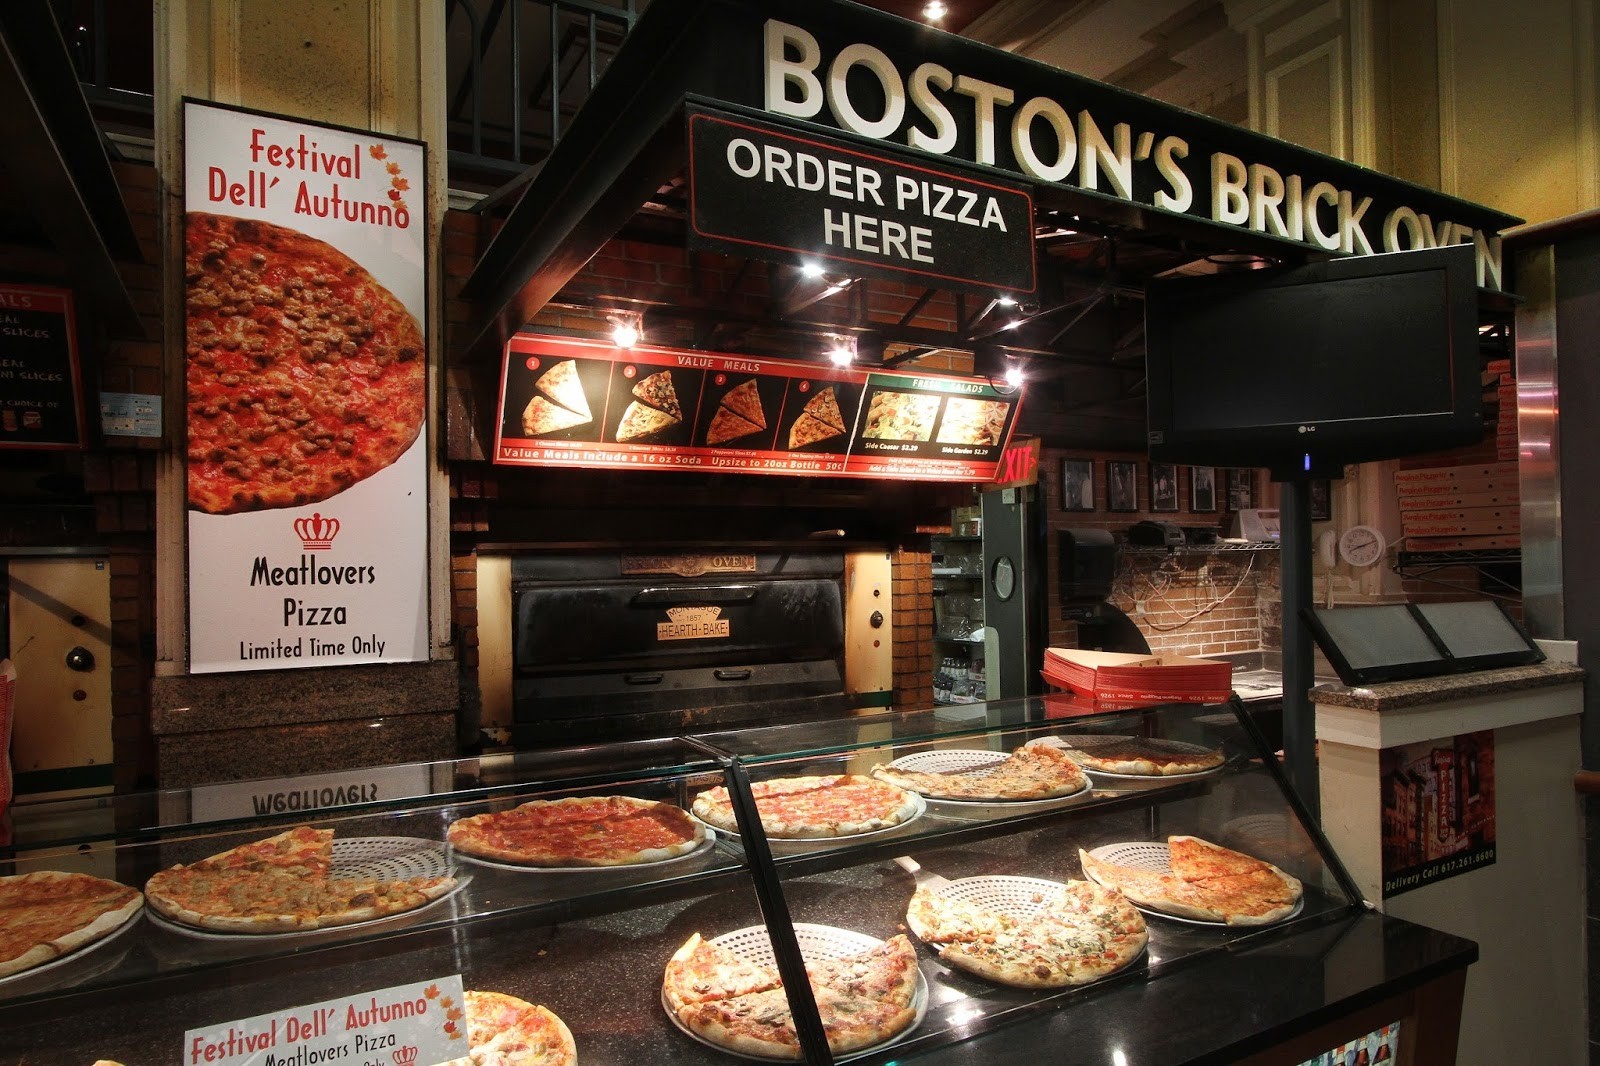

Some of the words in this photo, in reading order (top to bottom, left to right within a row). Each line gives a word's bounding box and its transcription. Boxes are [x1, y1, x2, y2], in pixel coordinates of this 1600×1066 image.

[763, 18, 1193, 214] BOSTON'S
[1211, 152, 1375, 256] BRICK
[250, 128, 360, 179] Festival
[726, 138, 884, 207] ORDER
[896, 175, 1008, 232] PIZZA
[295, 181, 410, 229] Autunno
[823, 208, 935, 264] HERE
[3, 327, 49, 339] SLICES
[0, 358, 25, 368] EAL
[19, 372, 63, 382] SLICES
[677, 356, 714, 368] VALUE
[723, 360, 760, 372] MEALS
[503, 448, 540, 459] Value
[544, 450, 580, 461] Meals
[583, 451, 628, 463] Include
[631, 455, 638, 463] a
[642, 455, 655, 463] 16
[675, 456, 701, 465] Soda
[712, 457, 747, 468] Upsize
[750, 460, 760, 468] to
[764, 460, 788, 469] 20oz
[790, 461, 820, 470] Bottle
[865, 442, 878, 450] Side
[997, 446, 1033, 483] XIT
[250, 554, 376, 587] Meatlovers
[713, 556, 751, 568] OVEN
[283, 598, 347, 626] Pizza
[240, 637, 302, 660] Limited
[309, 637, 345, 656] Time
[352, 634, 386, 657] Only
[1385, 872, 1420, 892] Delivery
[1422, 866, 1440, 879] Call
[191, 1020, 276, 1065] Festival
[345, 997, 428, 1031] Autunno
[265, 1042, 349, 1066] Meatlovers
[355, 1032, 396, 1054] Pizza
